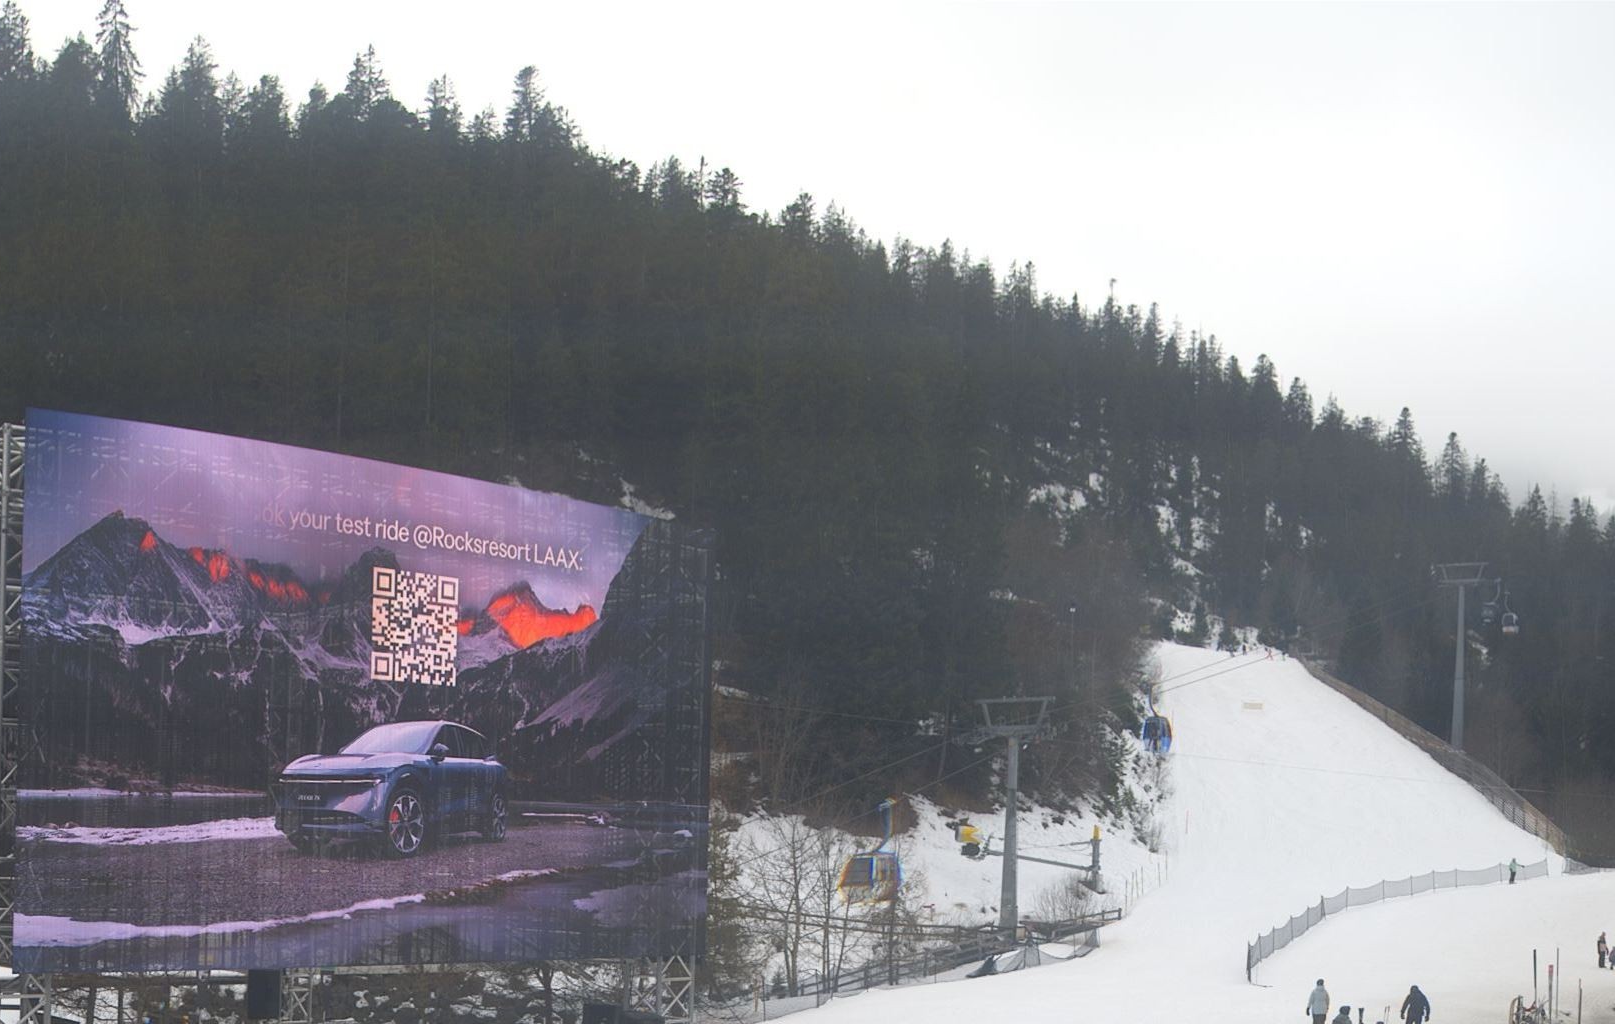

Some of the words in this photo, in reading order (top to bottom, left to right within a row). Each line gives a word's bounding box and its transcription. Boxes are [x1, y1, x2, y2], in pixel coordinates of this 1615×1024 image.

[288, 506, 333, 531] your
[336, 512, 371, 538] test
[374, 517, 409, 543] ride
[413, 523, 531, 563] @Rocksresort
[533, 543, 584, 571] LAAX:
